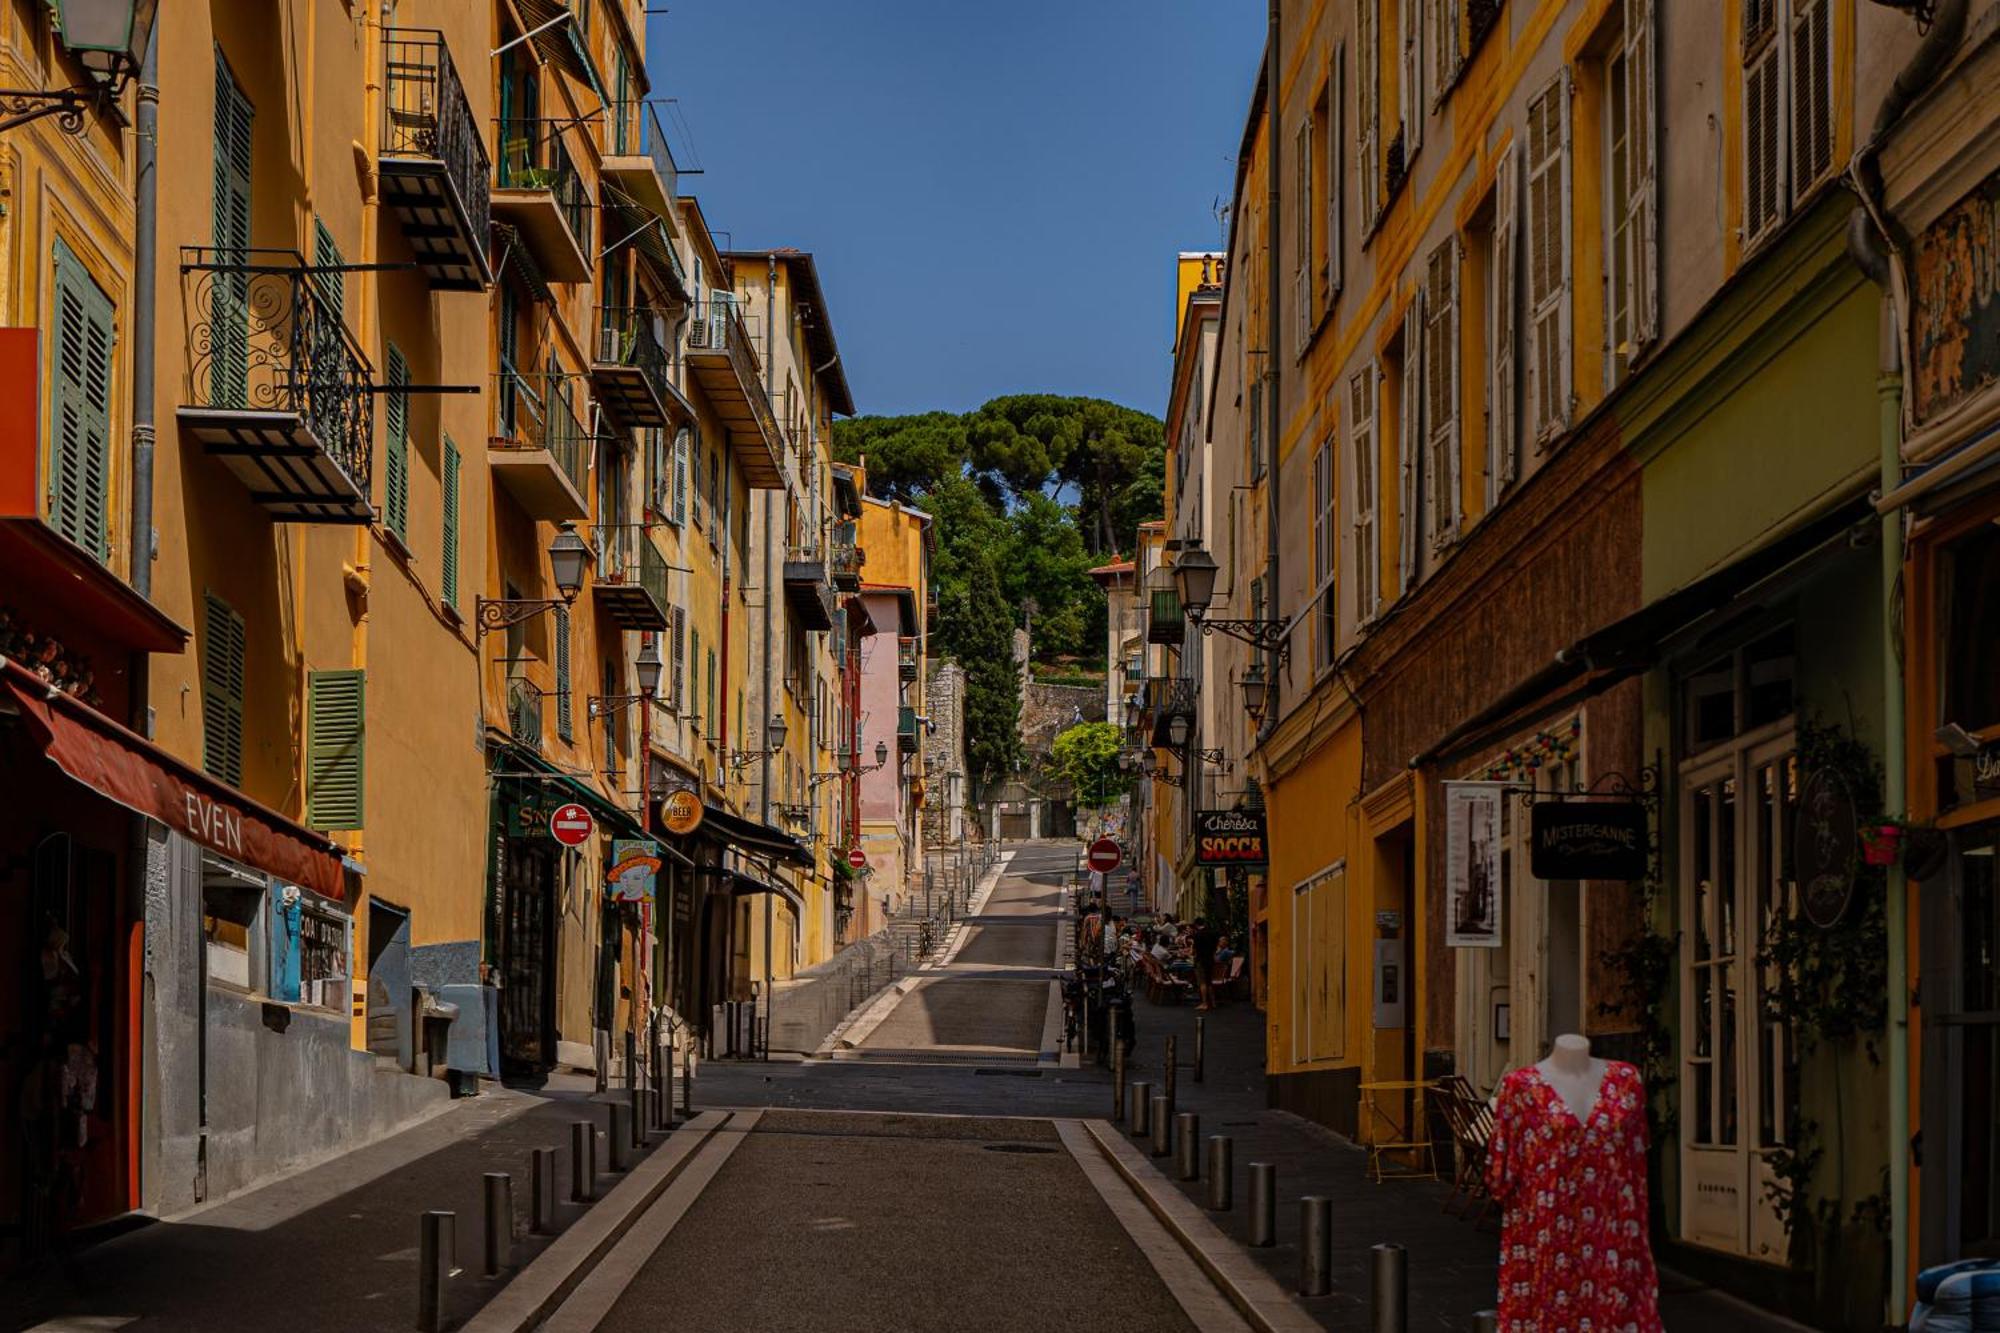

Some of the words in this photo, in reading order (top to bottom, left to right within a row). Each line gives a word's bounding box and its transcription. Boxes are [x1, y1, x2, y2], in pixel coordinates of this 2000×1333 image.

[185, 791, 242, 855] EVEN
[672, 806, 691, 817] BEER
[1201, 836, 1264, 861] SOCCA
